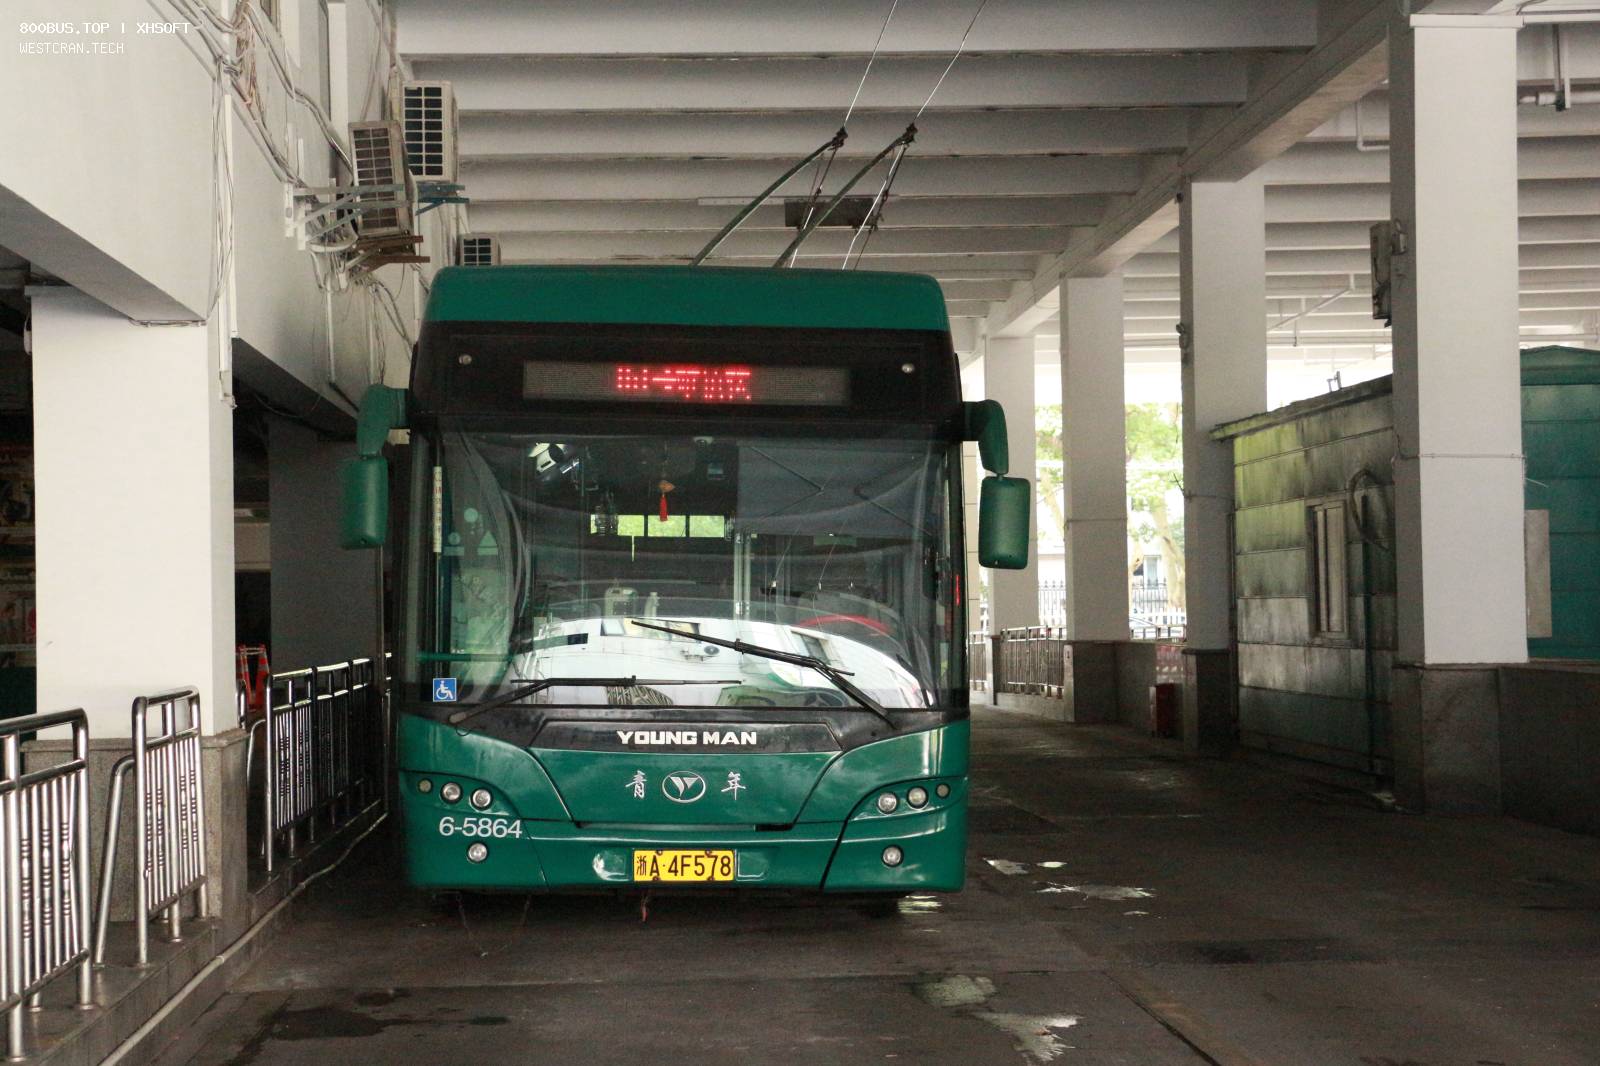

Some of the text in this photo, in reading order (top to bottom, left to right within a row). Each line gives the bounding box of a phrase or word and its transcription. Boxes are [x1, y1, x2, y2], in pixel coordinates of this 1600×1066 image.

[616, 730, 757, 745] YOUNG MAN
[625, 770, 746, 801] 青 年
[439, 816, 523, 839] 6-5864
